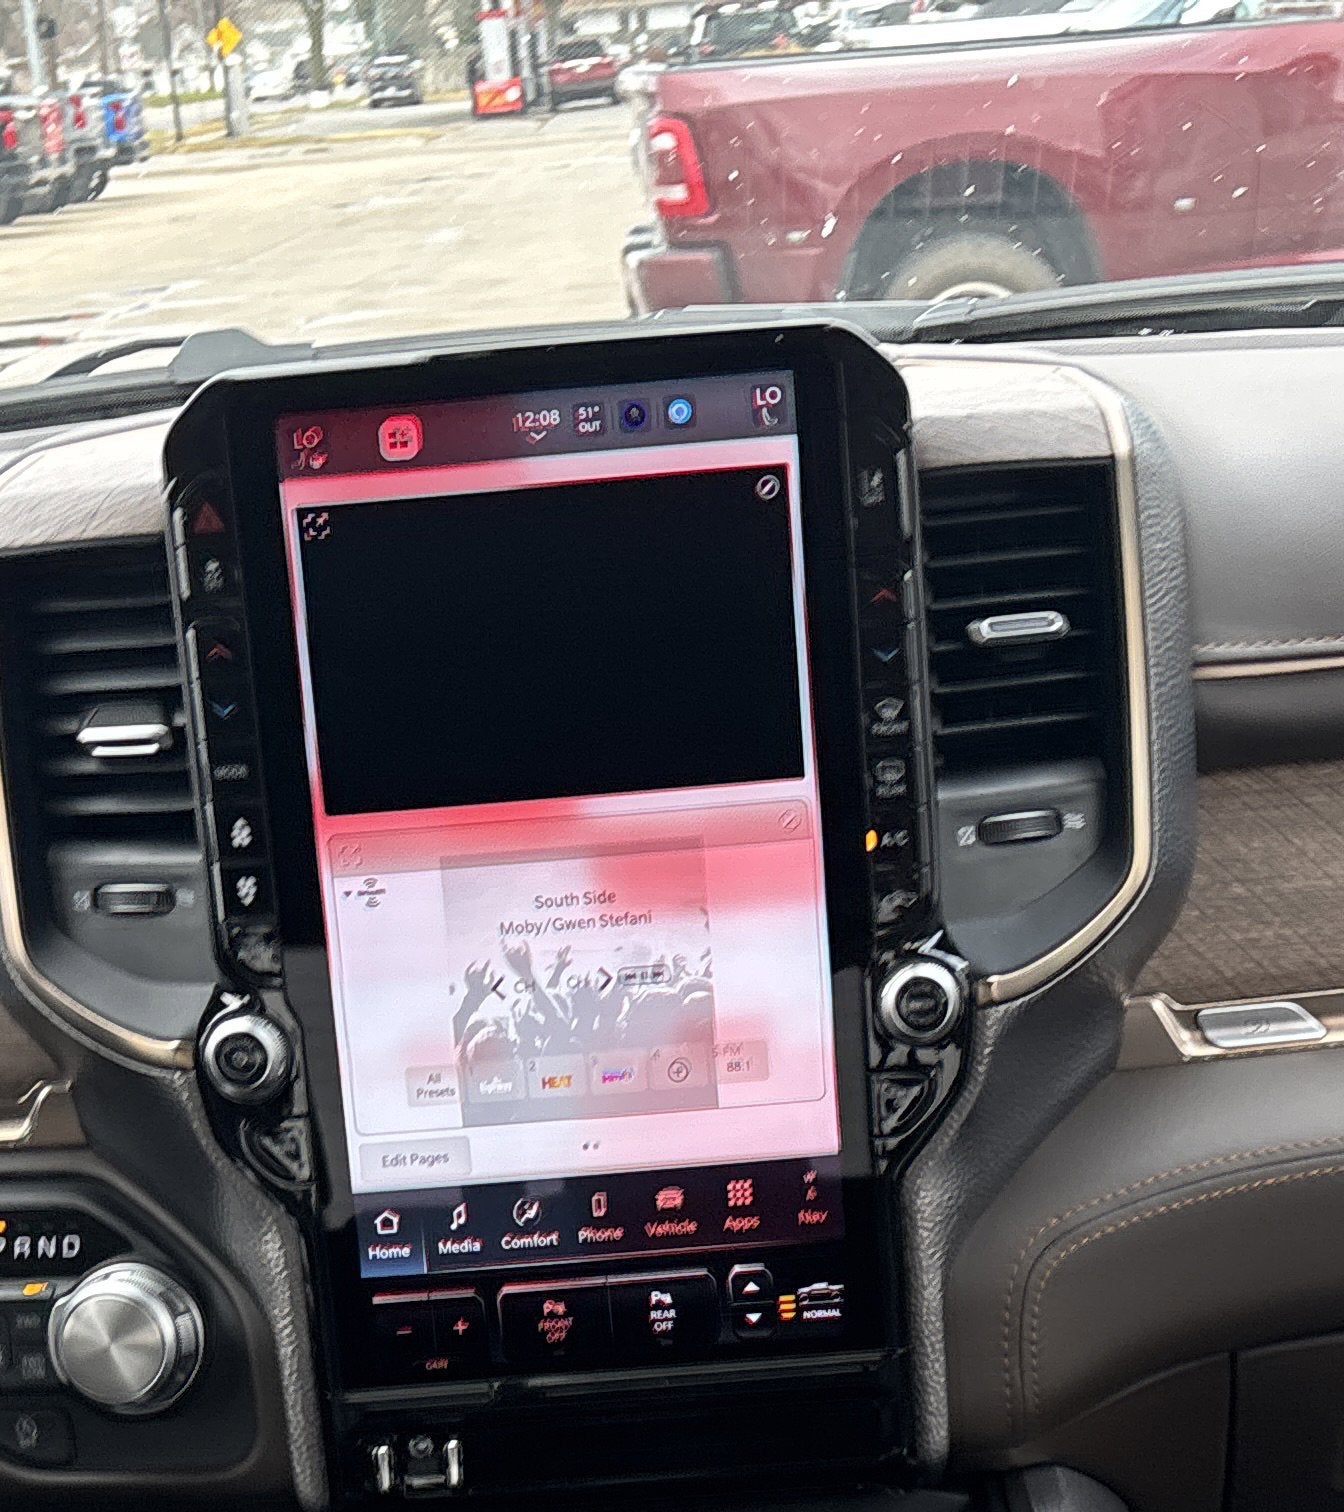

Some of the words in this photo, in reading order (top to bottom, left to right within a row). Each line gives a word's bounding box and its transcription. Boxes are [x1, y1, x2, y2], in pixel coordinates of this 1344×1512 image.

[753, 386, 781, 408] LO
[516, 409, 560, 429] 12:08
[578, 418, 601, 433] OUT
[293, 425, 323, 449] LO
[534, 892, 581, 909] South
[583, 889, 617, 906] Side
[499, 915, 597, 937] Moby/Gwen
[599, 909, 653, 928] Stefani
[426, 1072, 442, 1085] All
[541, 1074, 573, 1090] HEAT
[416, 1087, 456, 1099] Presets
[382, 1153, 408, 1168] Edit
[410, 1152, 450, 1169] Pages
[368, 1244, 410, 1261] Home
[438, 1238, 482, 1255] Media
[501, 1231, 559, 1250] Comfort
[578, 1225, 624, 1244] Phone
[644, 1218, 698, 1239] Vehicle
[723, 1214, 761, 1234] Apps
[62, 1234, 81, 1259] D
[651, 1309, 677, 1321] REAR
[803, 1307, 842, 1319] NORMAL
[653, 1320, 674, 1332] OFF
